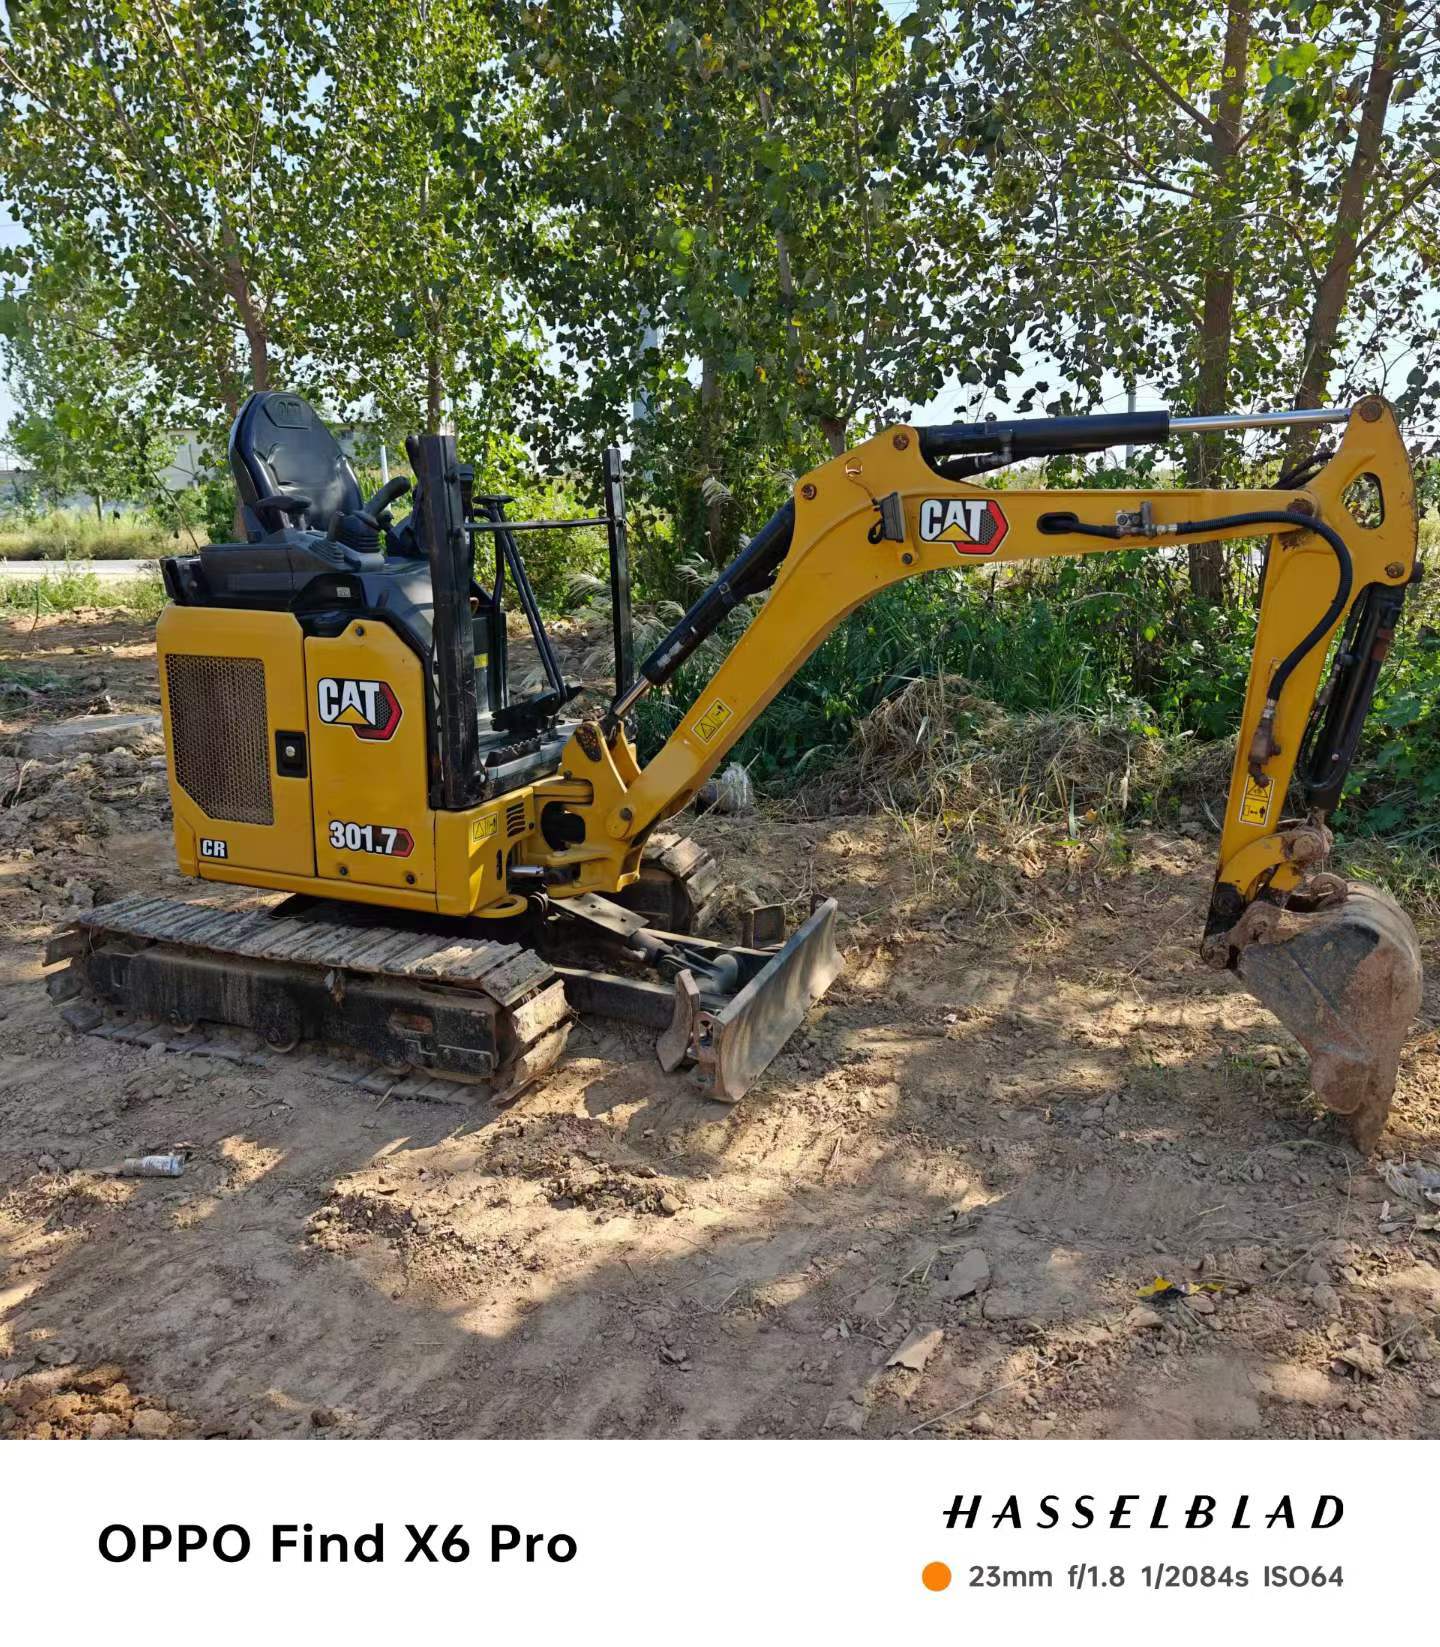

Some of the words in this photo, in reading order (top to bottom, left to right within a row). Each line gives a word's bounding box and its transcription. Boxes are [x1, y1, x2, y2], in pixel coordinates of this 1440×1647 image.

[920, 499, 988, 542] CAT
[318, 678, 380, 725] CAT
[202, 839, 226, 857] CR
[329, 820, 398, 855] 301.7
